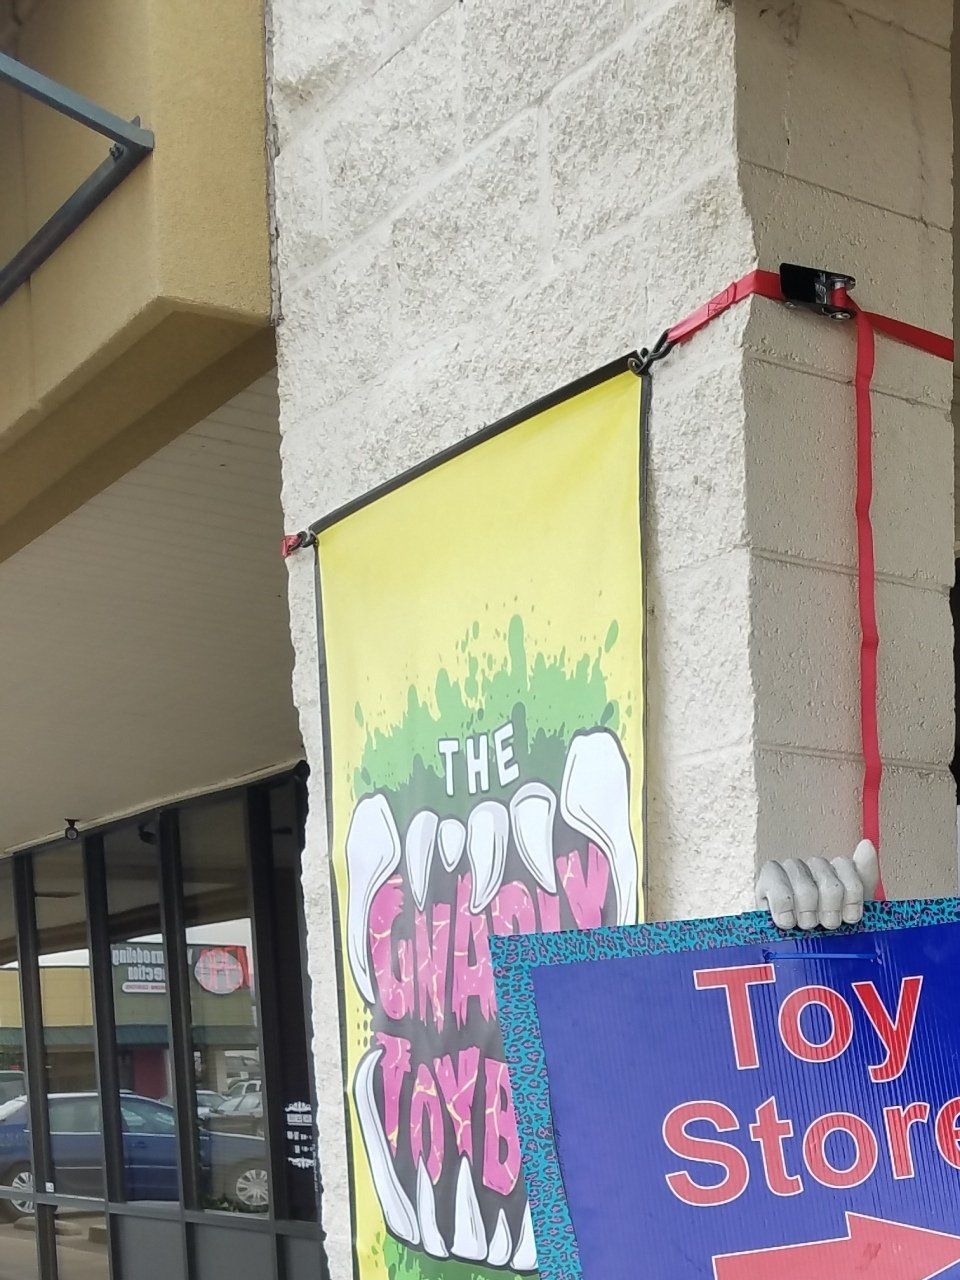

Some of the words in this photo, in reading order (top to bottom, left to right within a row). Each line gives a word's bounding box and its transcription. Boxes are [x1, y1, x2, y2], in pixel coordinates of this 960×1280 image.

[439, 723, 519, 796] THE
[369, 842, 610, 1034] GNAY
[693, 963, 923, 1083] Toy
